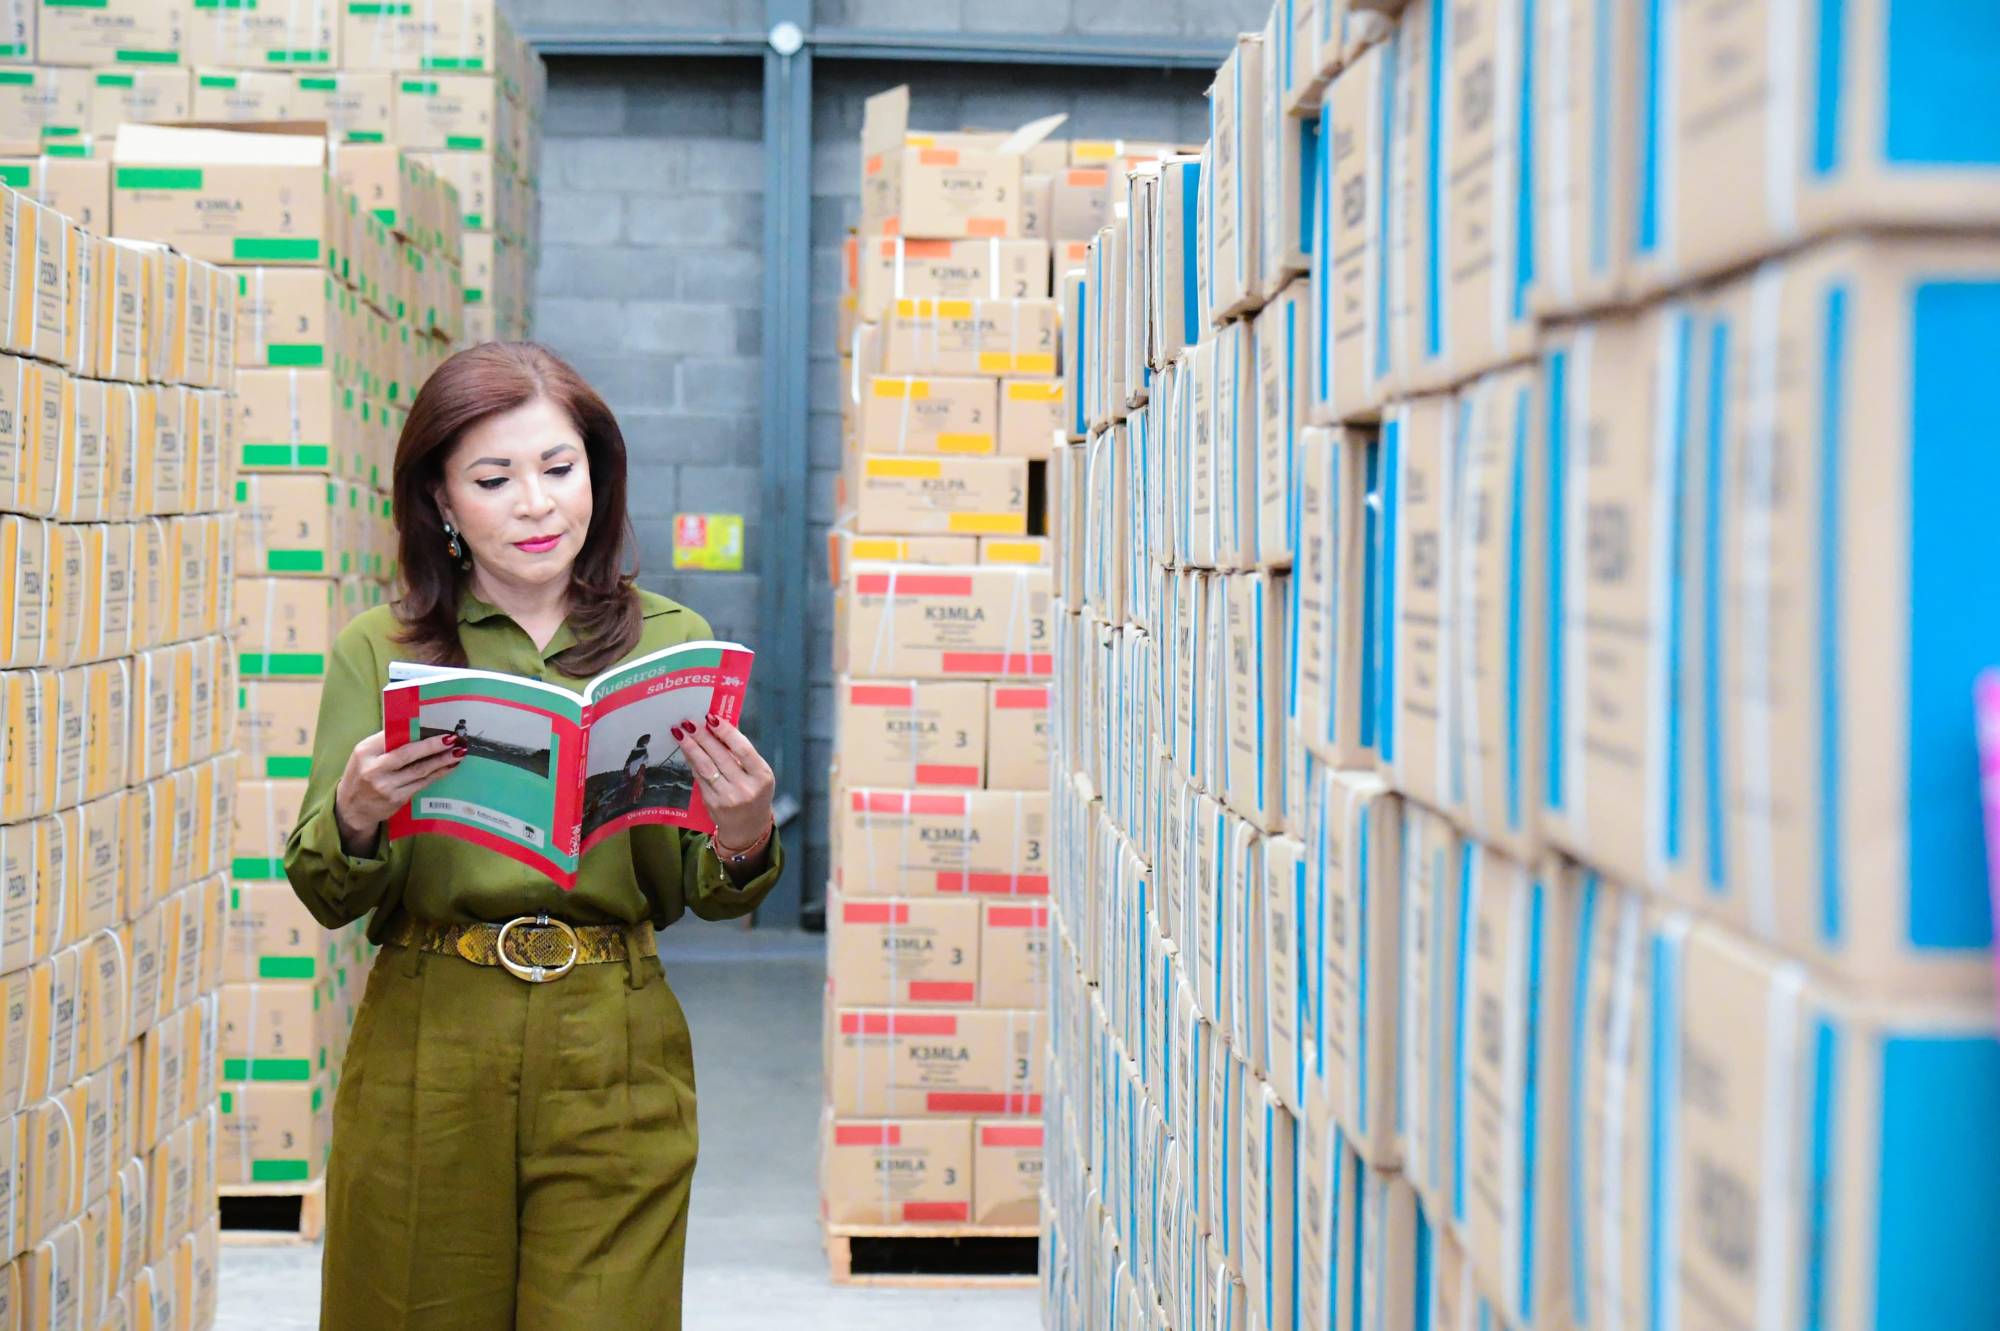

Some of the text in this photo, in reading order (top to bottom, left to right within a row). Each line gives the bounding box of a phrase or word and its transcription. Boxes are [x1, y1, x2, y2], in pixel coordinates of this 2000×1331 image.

[1027, 213, 1037, 230] 2
[1017, 281, 1026, 297] 2
[299, 316, 308, 332] 3
[1041, 329, 1050, 344] 2
[972, 410, 980, 423] 2
[1011, 488, 1021, 504] 2
[297, 520, 308, 538] 3
[925, 608, 984, 621] K3MLA
[1031, 619, 1045, 638] 3
[594, 665, 667, 701] Nuestros
[647, 674, 716, 696] saberes:
[297, 728, 306, 744] 3
[956, 731, 967, 747] 3
[659, 808, 687, 818] GRADO
[920, 829, 980, 842] K3MLA
[1026, 841, 1040, 860] 3
[289, 930, 299, 945] 3
[952, 948, 962, 964] 3
[909, 1048, 969, 1061] K3MLA
[1015, 1059, 1028, 1078] 3
[282, 1131, 293, 1148] 3
[944, 1168, 955, 1185] 3
